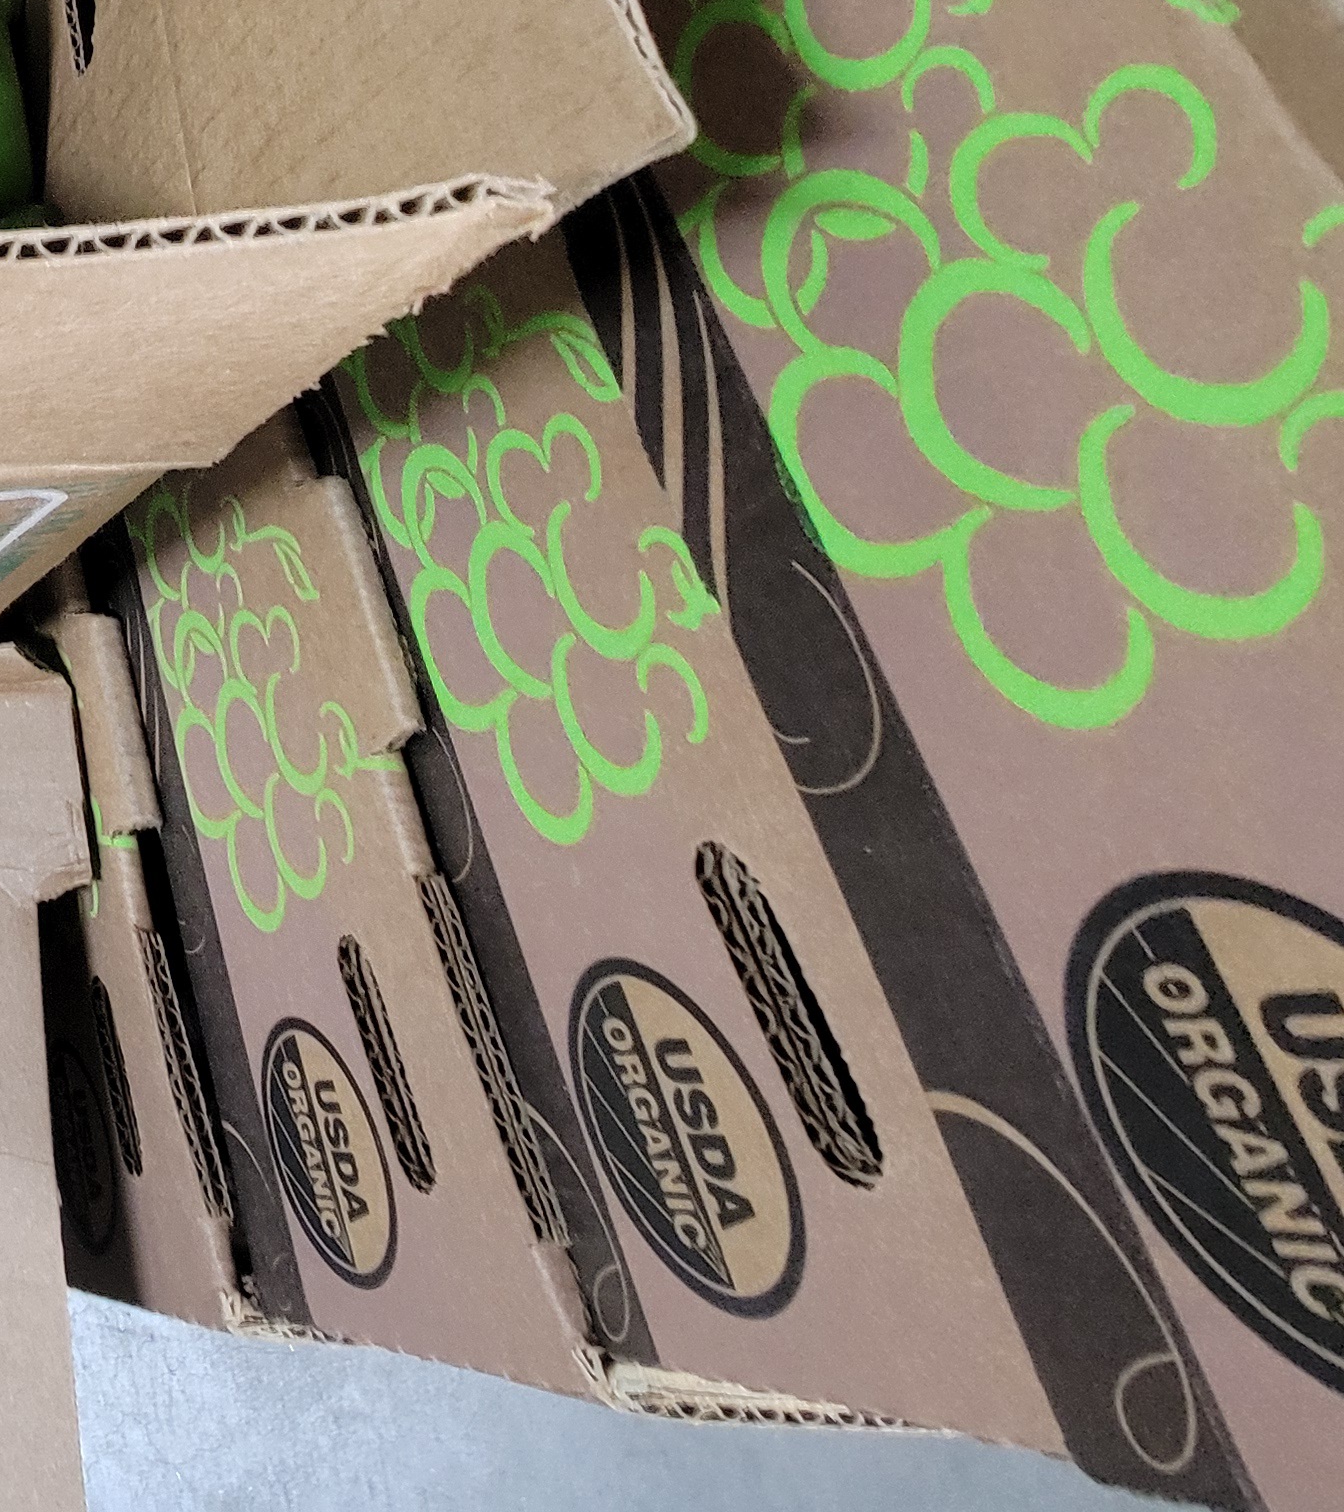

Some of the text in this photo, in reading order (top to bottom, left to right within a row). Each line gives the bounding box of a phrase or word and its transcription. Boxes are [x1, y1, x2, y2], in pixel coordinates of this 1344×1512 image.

[282, 1061, 340, 1239] ORGANIC
[315, 1078, 370, 1224] USDA
[601, 1016, 707, 1251] ORGANIC
[654, 1037, 756, 1231] USDA
[1142, 961, 1344, 1324] ORGANIC
